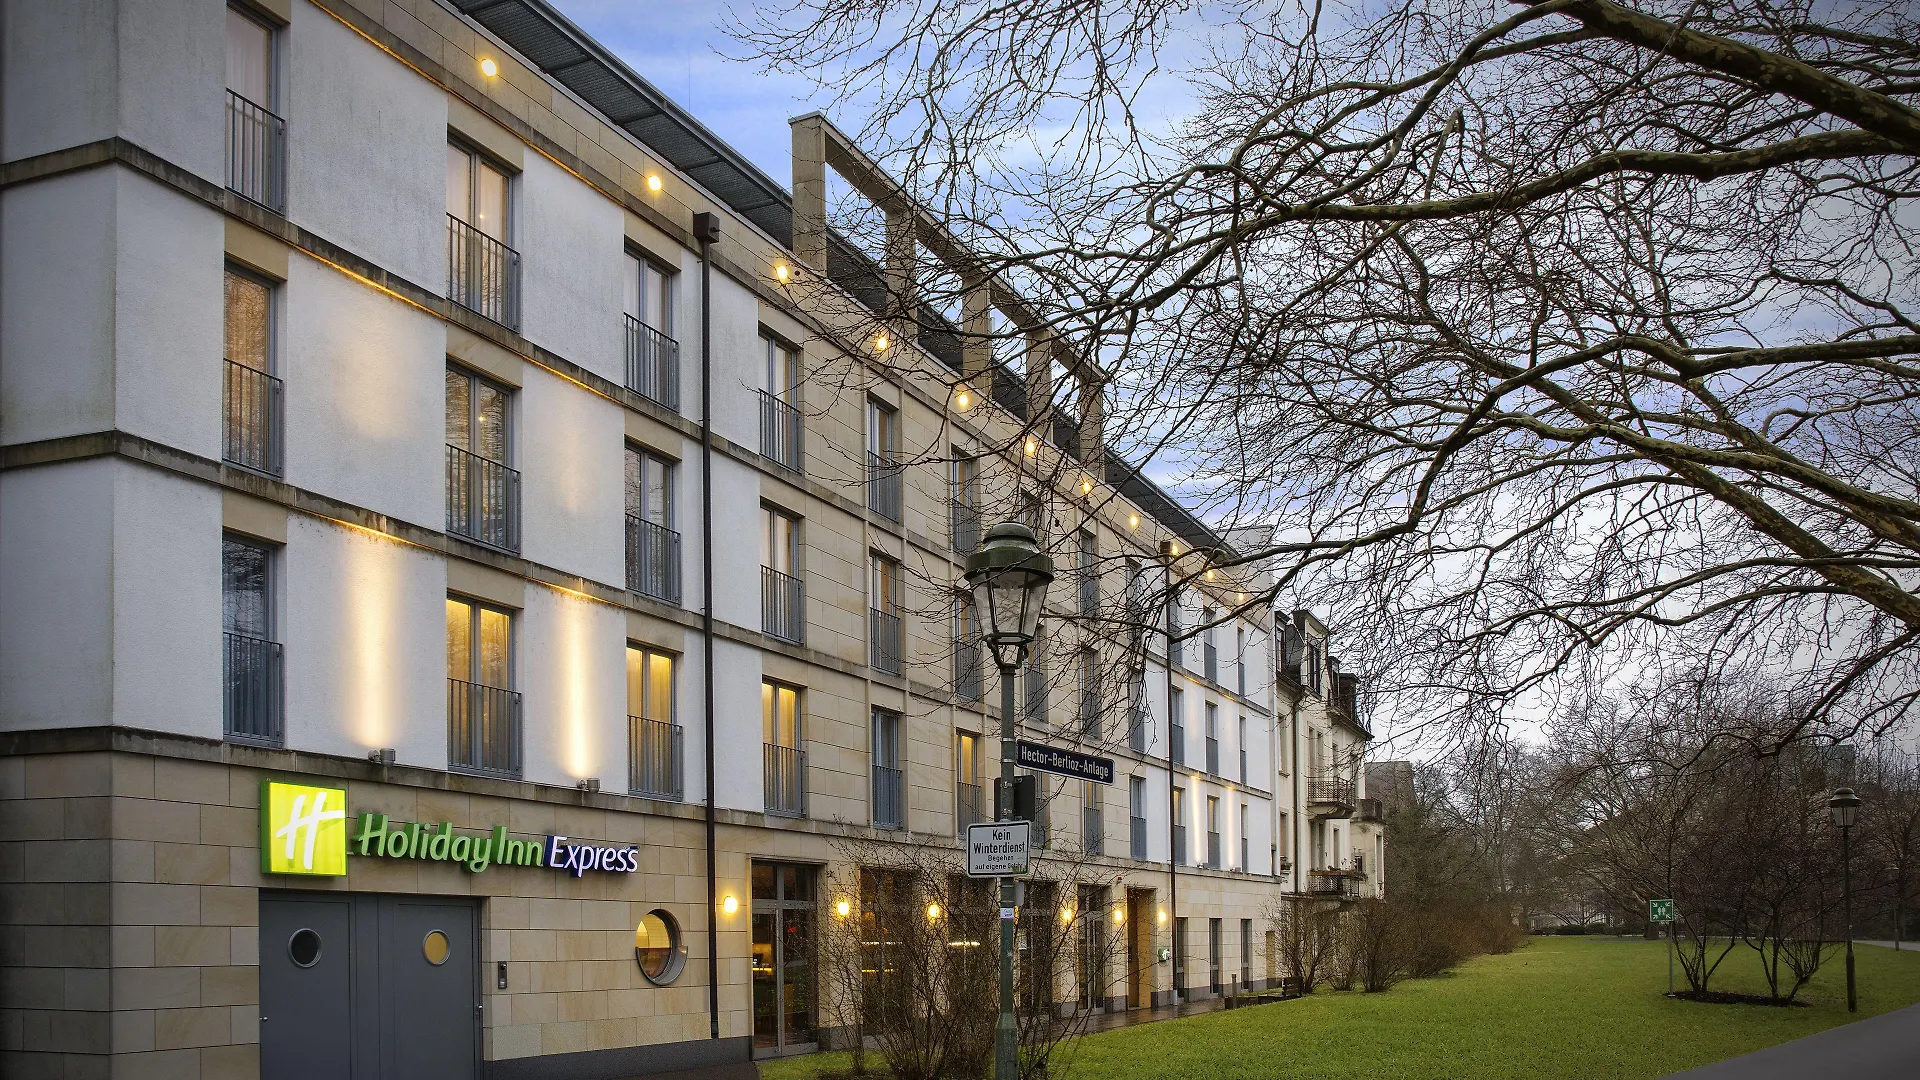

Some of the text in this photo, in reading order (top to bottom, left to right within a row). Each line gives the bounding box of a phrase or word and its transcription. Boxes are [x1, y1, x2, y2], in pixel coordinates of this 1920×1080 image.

[1021, 745, 1109, 779] Hector-Berlioz-Anlage
[276, 791, 345, 870] H
[355, 813, 639, 878] Holiday Inn Express
[973, 841, 1026, 854] Winterdienst
[992, 829, 1011, 841] Kein
